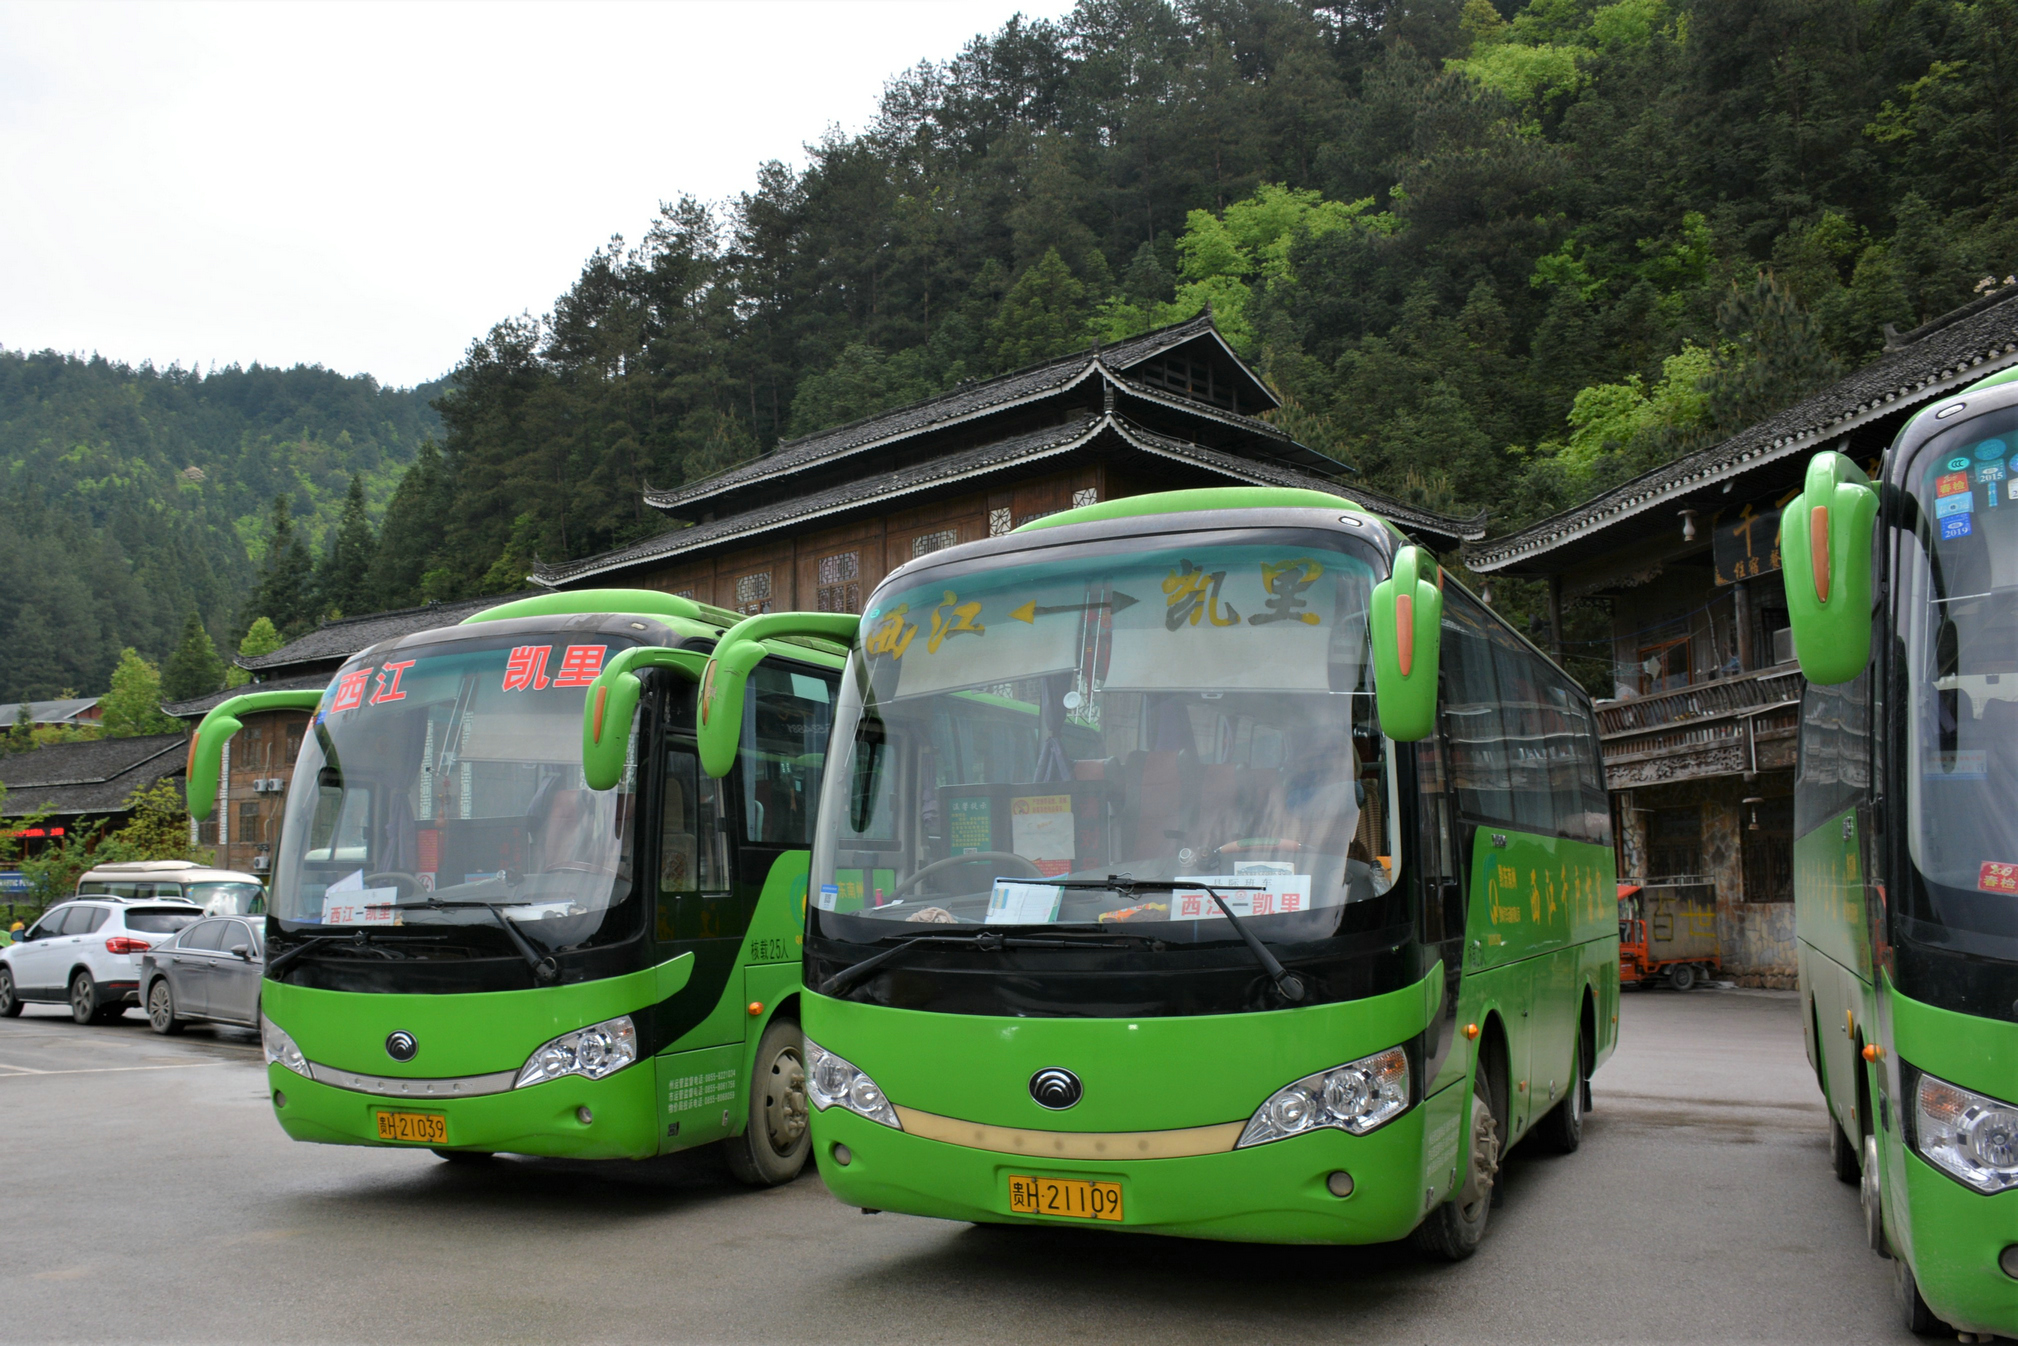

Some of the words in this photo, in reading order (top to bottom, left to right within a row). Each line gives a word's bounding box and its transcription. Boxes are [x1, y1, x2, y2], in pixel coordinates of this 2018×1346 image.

[1979, 471, 2004, 483] 2015
[1945, 527, 1969, 538] 2019
[866, 591, 986, 660] 西江
[1162, 556, 1325, 632] 凯里
[330, 659, 416, 715] 西江
[502, 645, 608, 692] 凯里
[1984, 875, 2017, 889] 春检
[1012, 1181, 1119, 1214] 贵H·21109
